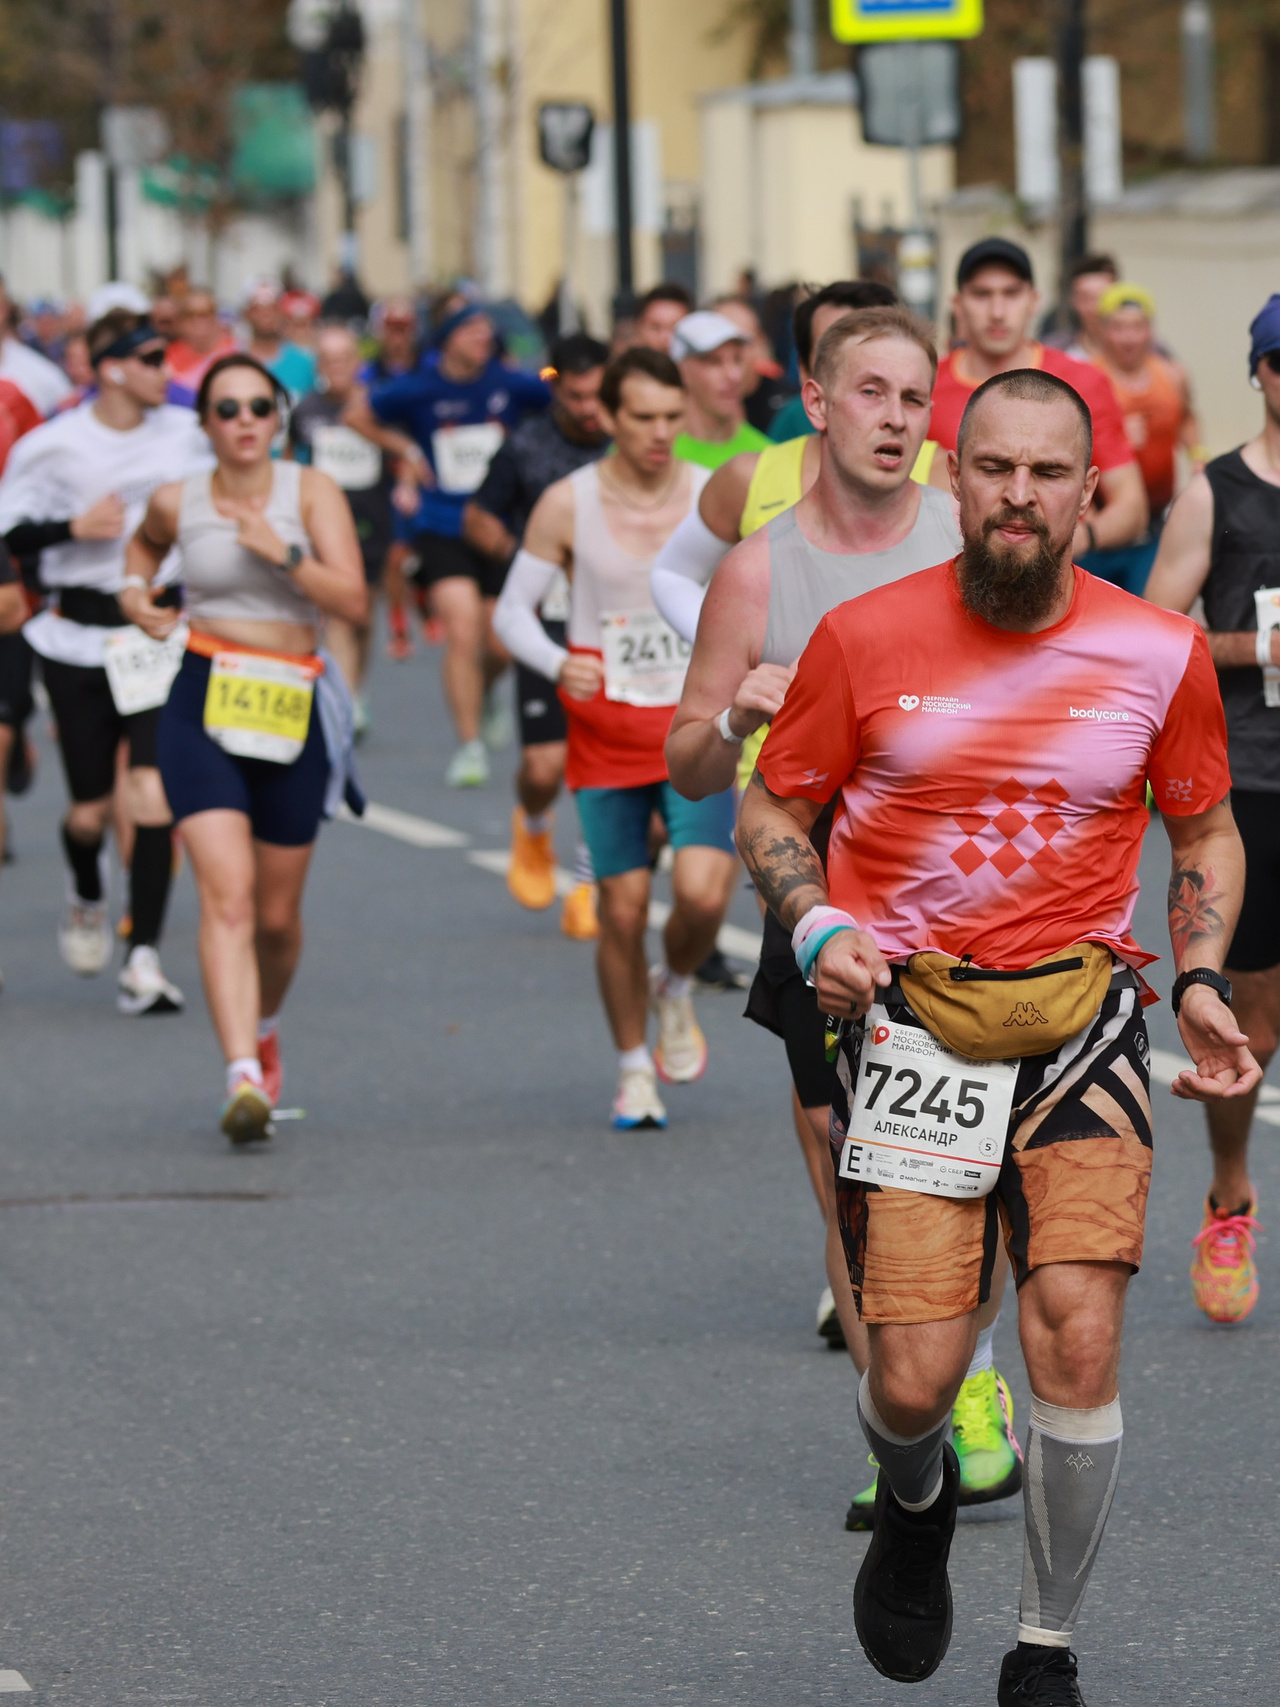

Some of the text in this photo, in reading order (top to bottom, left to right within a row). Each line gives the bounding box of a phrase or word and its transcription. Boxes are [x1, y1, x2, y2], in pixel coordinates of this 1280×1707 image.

[922, 701, 972, 710] МОСКОВСКИЙ
[923, 695, 959, 703] СБЕРПРАЙМ
[921, 706, 958, 714] МАРАФОН
[1069, 706, 1130, 722] bodycore
[894, 1028, 940, 1044] СБЕРПРАЙМ
[891, 1043, 936, 1057] МАРАФОН
[893, 1034, 953, 1055] МОСКОВСКИЙ
[864, 1061, 989, 1129] 7245
[874, 1120, 958, 1147] АЛЕКСАНДР
[984, 1143, 992, 1151] 5
[846, 1144, 864, 1174] E
[948, 1168, 964, 1176] СБЕР
